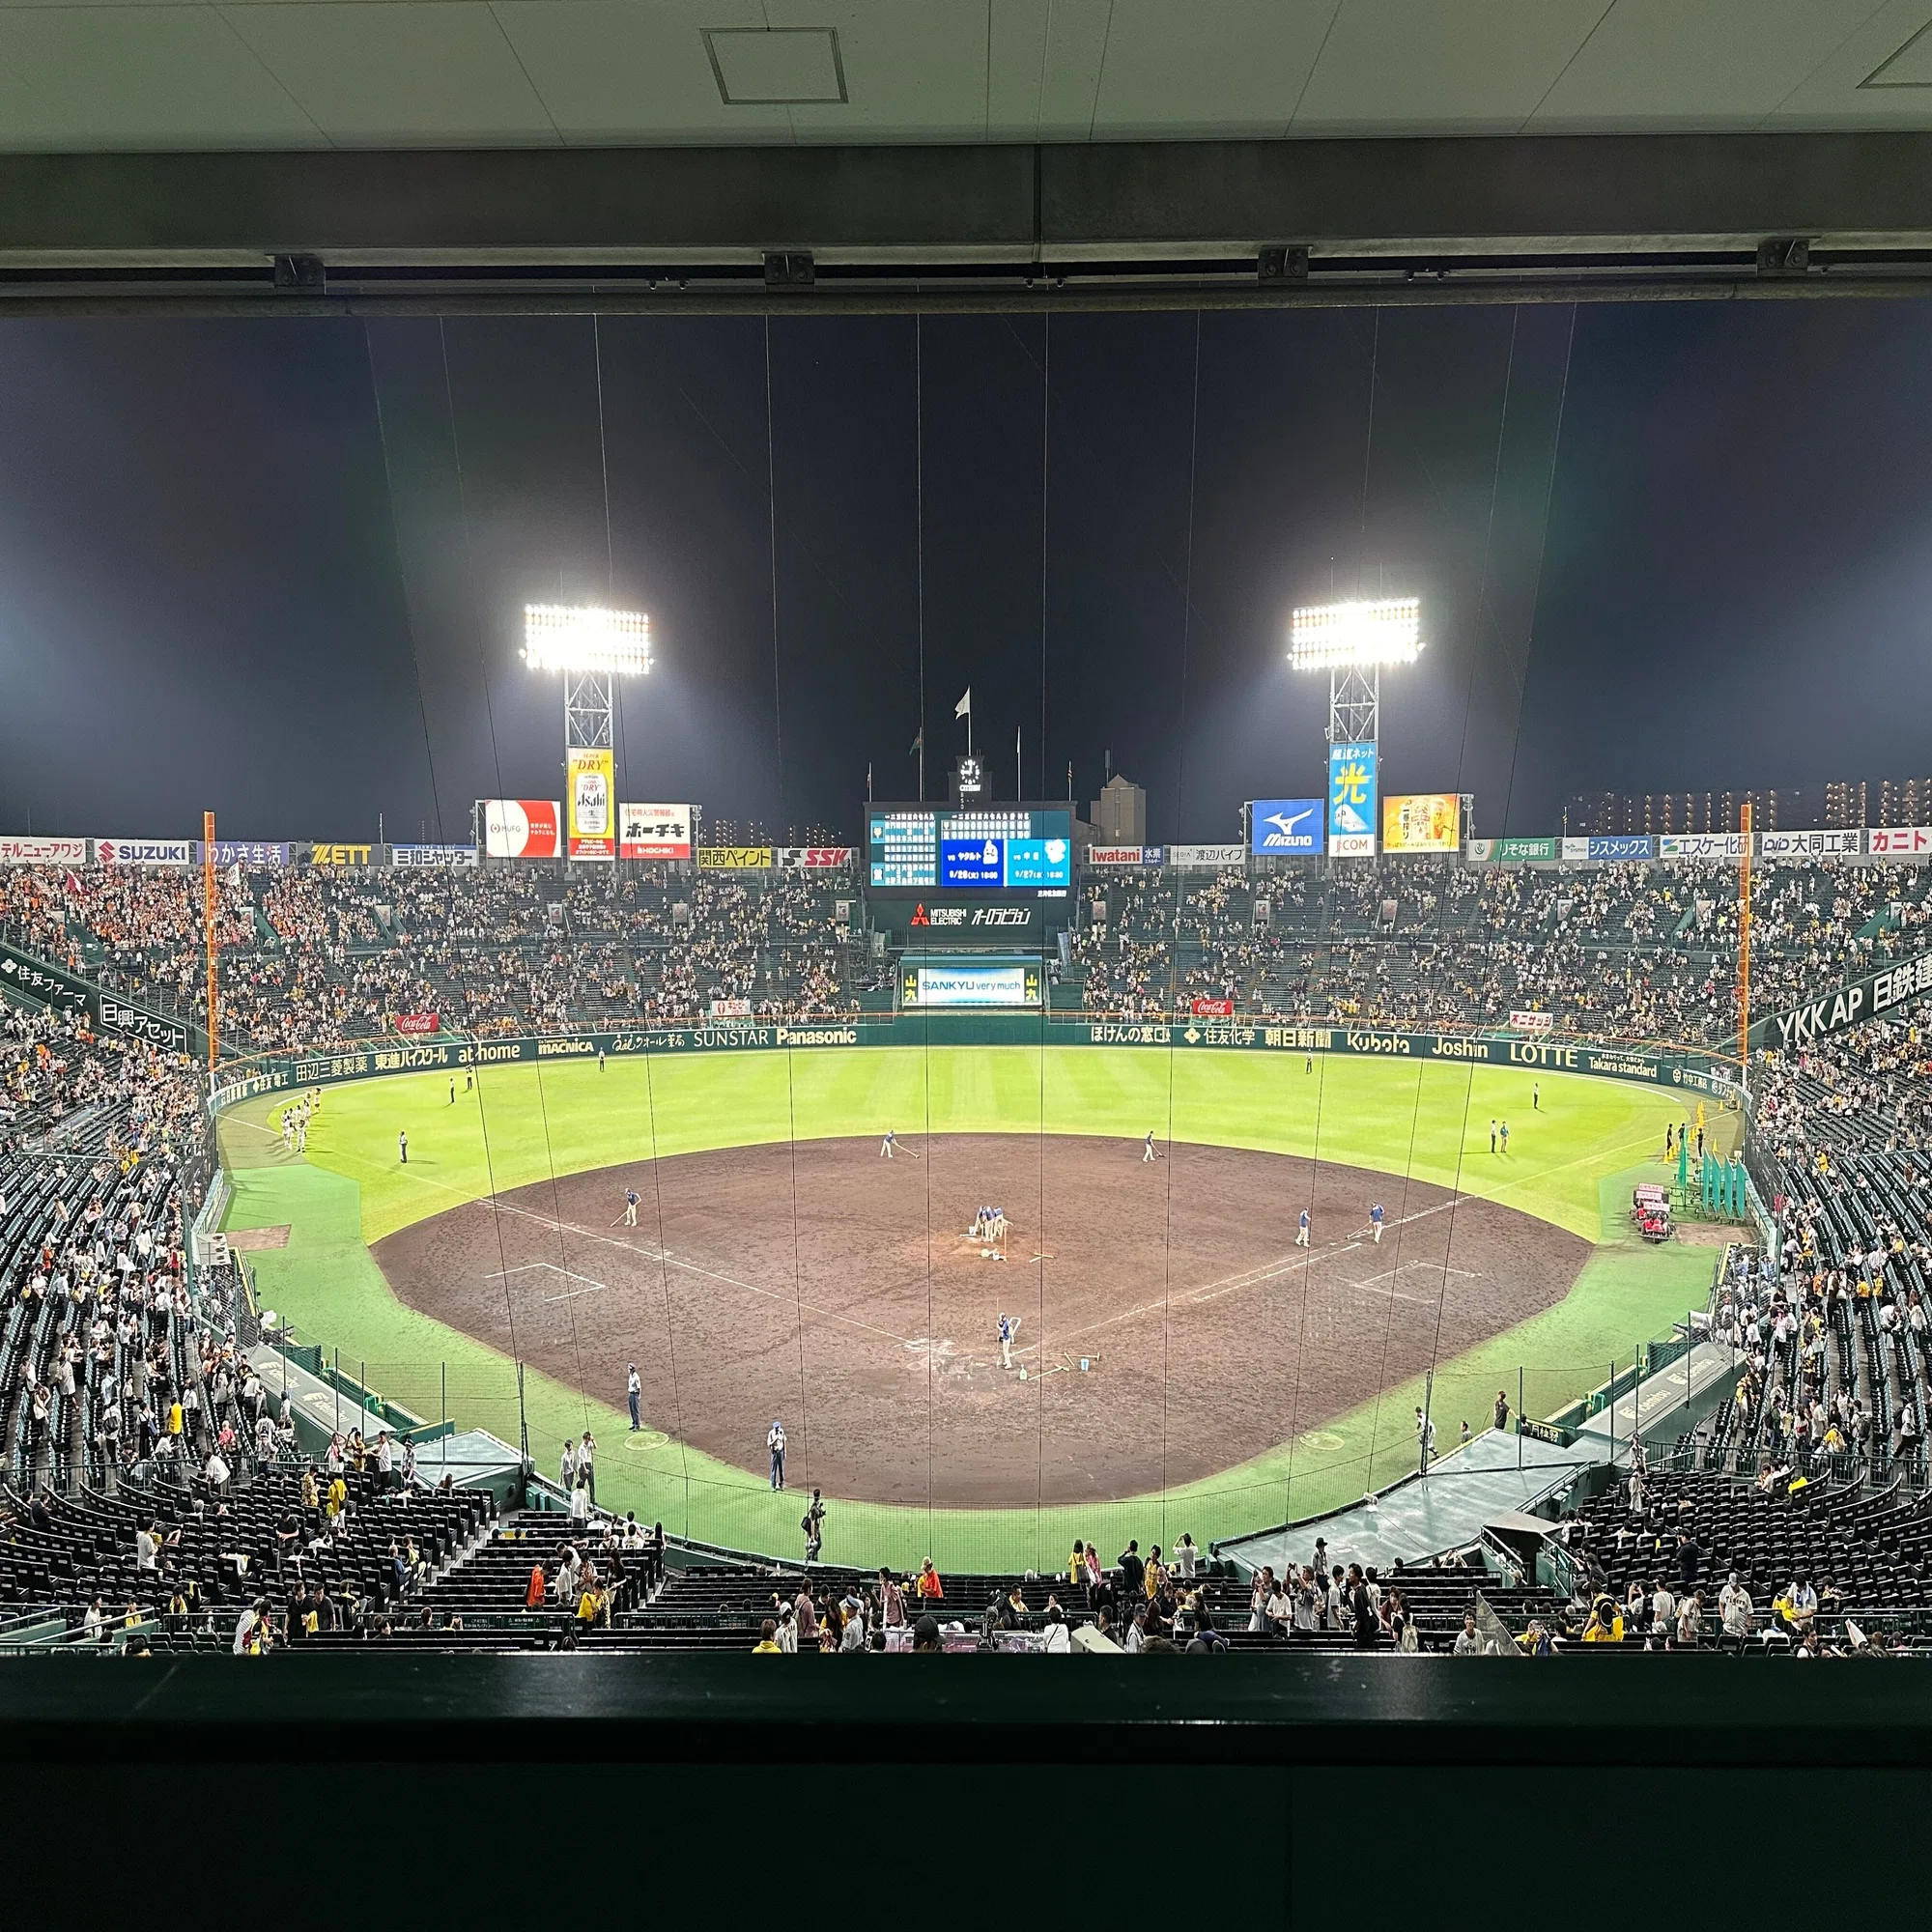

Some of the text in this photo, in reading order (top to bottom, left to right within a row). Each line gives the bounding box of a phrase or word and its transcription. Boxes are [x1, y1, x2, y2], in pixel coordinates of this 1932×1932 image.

[1333, 762, 1373, 805] 光
[578, 793, 605, 807] Asahi
[626, 823, 684, 838] ホーチキ
[1, 842, 83, 858] テルニューアワジ
[1500, 842, 1549, 857] りそな銀行
[1590, 839, 1649, 856] シスメックス
[1792, 833, 1858, 853] 大同工業
[1872, 831, 1932, 852] カニト
[119, 845, 185, 860] SUZUKI
[397, 850, 472, 865] 三和シャッター
[698, 850, 770, 867] 関西ペイント
[805, 850, 849, 866] SSK
[1092, 849, 1140, 862] Iwatani
[1195, 848, 1244, 861] 渡辺パイプ
[17, 965, 87, 1007] 住友ファーマ
[905, 975, 917, 1002] 山九
[923, 980, 1021, 991] SANKYU very much
[1026, 974, 1037, 1001] 山九
[1198, 1001, 1227, 1014] Coca-Cola
[1776, 987, 1863, 1041] YKK AP
[102, 1004, 185, 1046] 日興アセット
[401, 1016, 432, 1032] Coca-Cola
[694, 1031, 769, 1047] SUNSTAR
[777, 1027, 856, 1044] Panasonic
[1091, 1026, 1166, 1043] ほけんの窓口
[1204, 1029, 1256, 1045] 住友化学
[1264, 1030, 1331, 1048] 朝日新聞
[458, 1042, 521, 1063] at home
[1432, 1037, 1489, 1058] Joshin
[1510, 1043, 1578, 1067] LOTTE
[375, 1047, 448, 1069] 東進ハイスクール
[296, 1055, 368, 1083] 田辺三菱製薬
[1588, 1056, 1658, 1078] Takara standard
